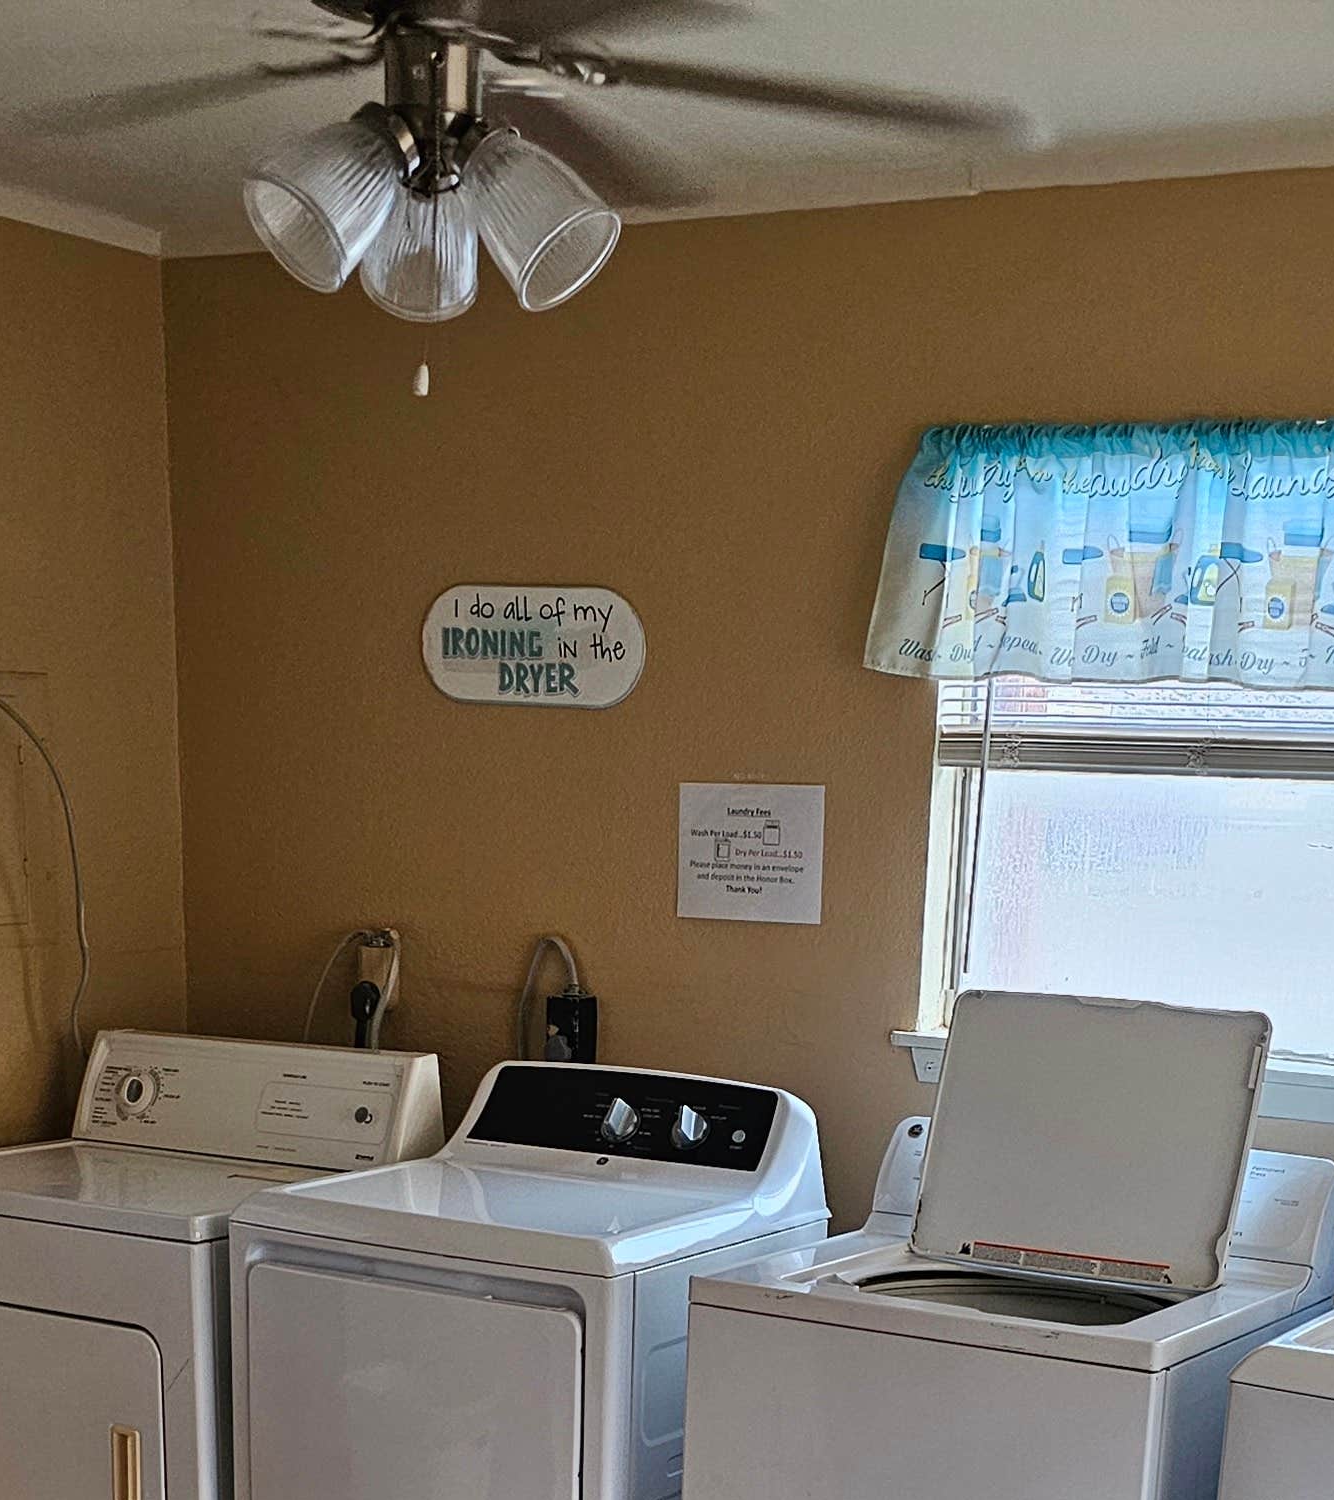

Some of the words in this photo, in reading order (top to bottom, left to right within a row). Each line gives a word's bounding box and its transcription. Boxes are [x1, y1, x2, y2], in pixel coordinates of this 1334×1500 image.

[454, 599, 459, 618] I
[470, 593, 495, 618] do
[539, 597, 566, 626] of
[573, 604, 614, 632] my
[442, 627, 544, 660] IRONING
[590, 633, 626, 663] the
[1082, 645, 1118, 667] Dry
[1239, 651, 1275, 675] Dry
[498, 662, 580, 697] DRYER
[690, 828, 709, 837] Wash
[735, 848, 747, 857] Dry
[726, 885, 746, 893] Thank
